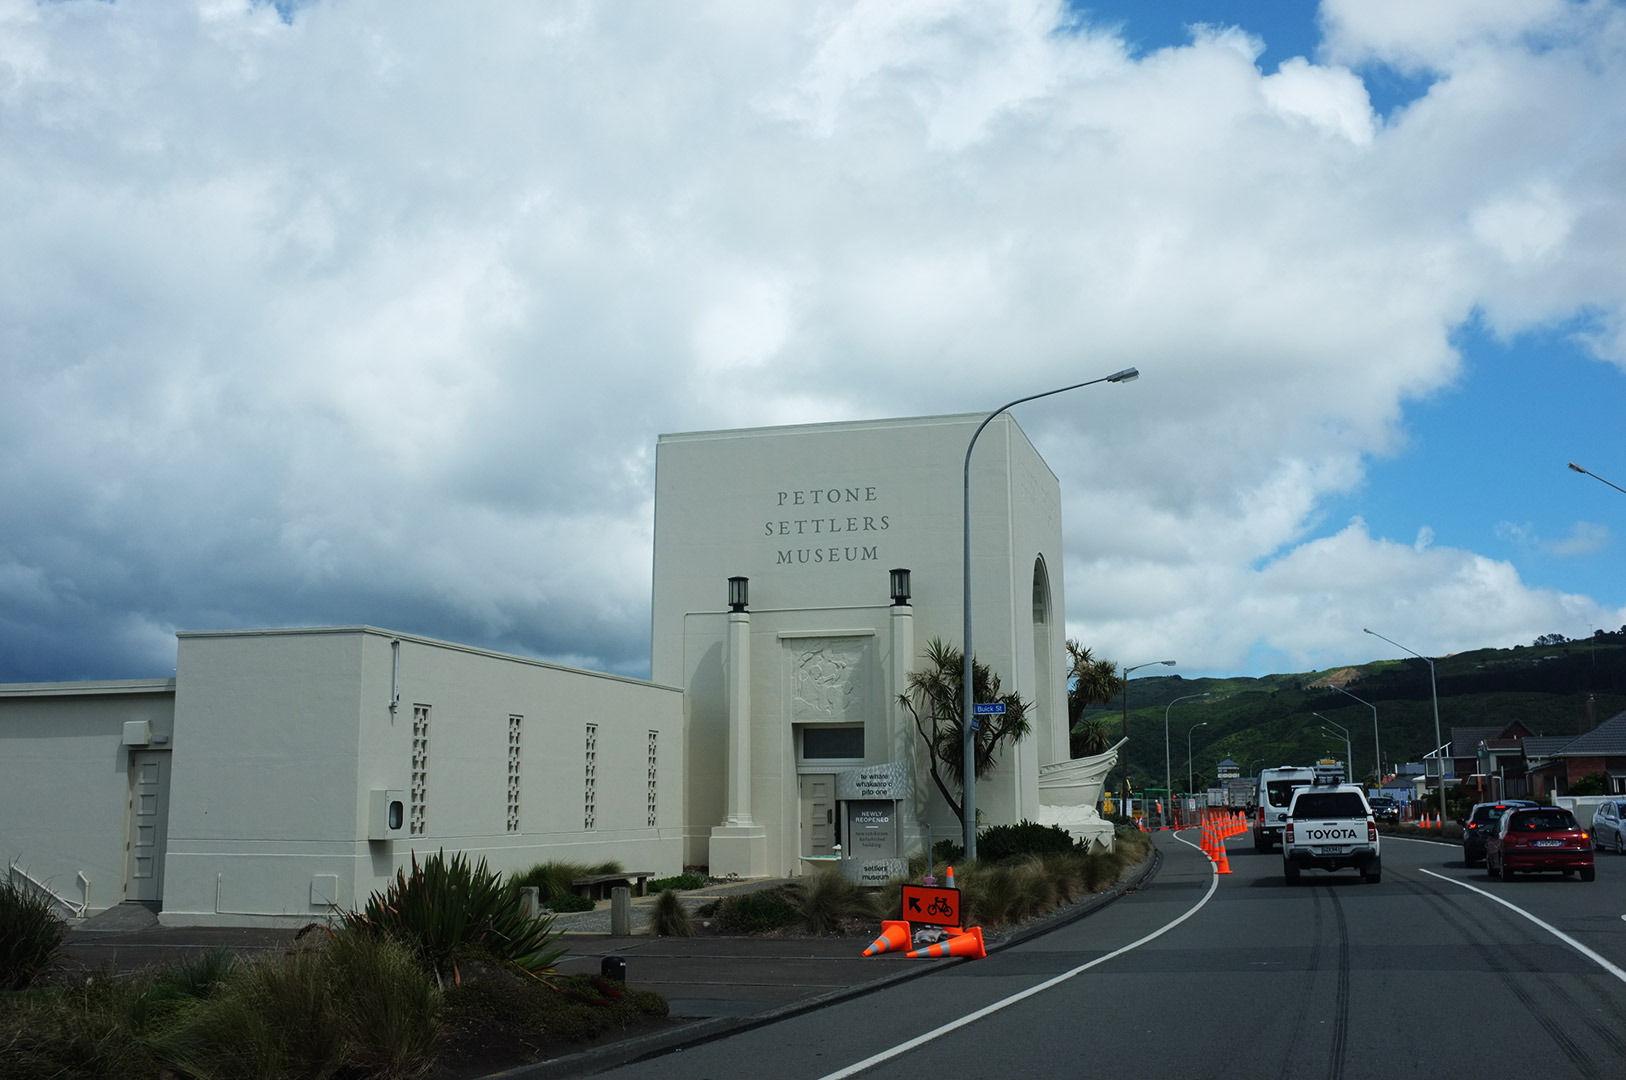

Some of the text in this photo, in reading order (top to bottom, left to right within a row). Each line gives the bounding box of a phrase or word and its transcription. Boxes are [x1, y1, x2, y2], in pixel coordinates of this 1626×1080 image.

[777, 487, 877, 506] PETONE
[765, 516, 889, 536] SETTLERS
[776, 546, 878, 564] MUSEUM
[1306, 829, 1357, 839] TOYOTA
